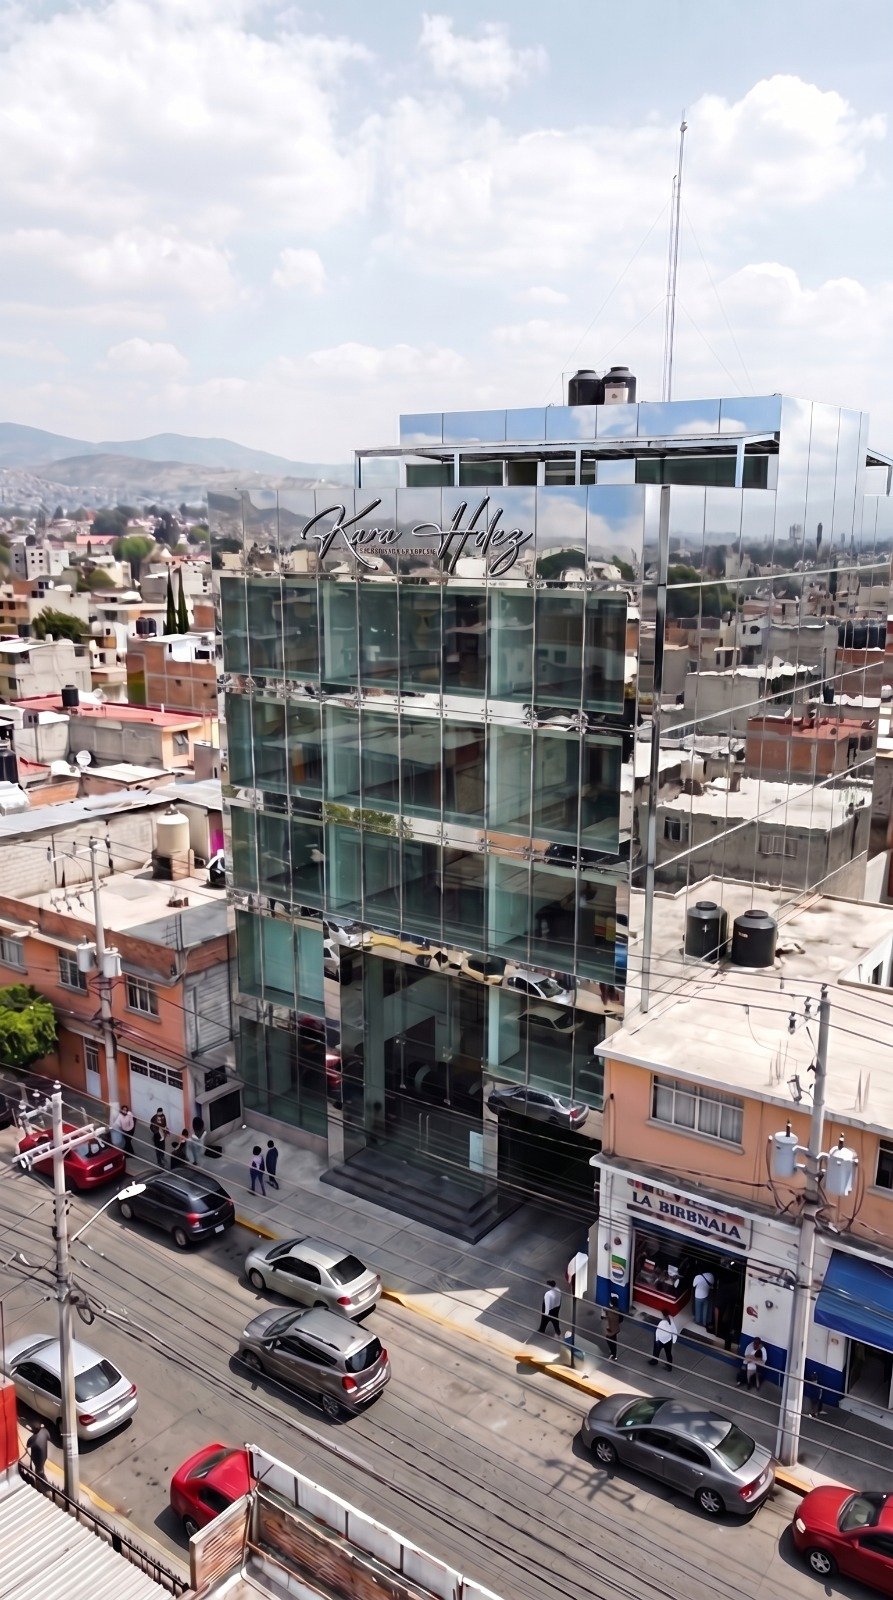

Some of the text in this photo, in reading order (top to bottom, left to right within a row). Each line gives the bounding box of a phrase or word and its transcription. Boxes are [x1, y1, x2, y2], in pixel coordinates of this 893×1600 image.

[300, 495, 534, 577] Kara Hdez
[633, 1191, 652, 1208] LA
